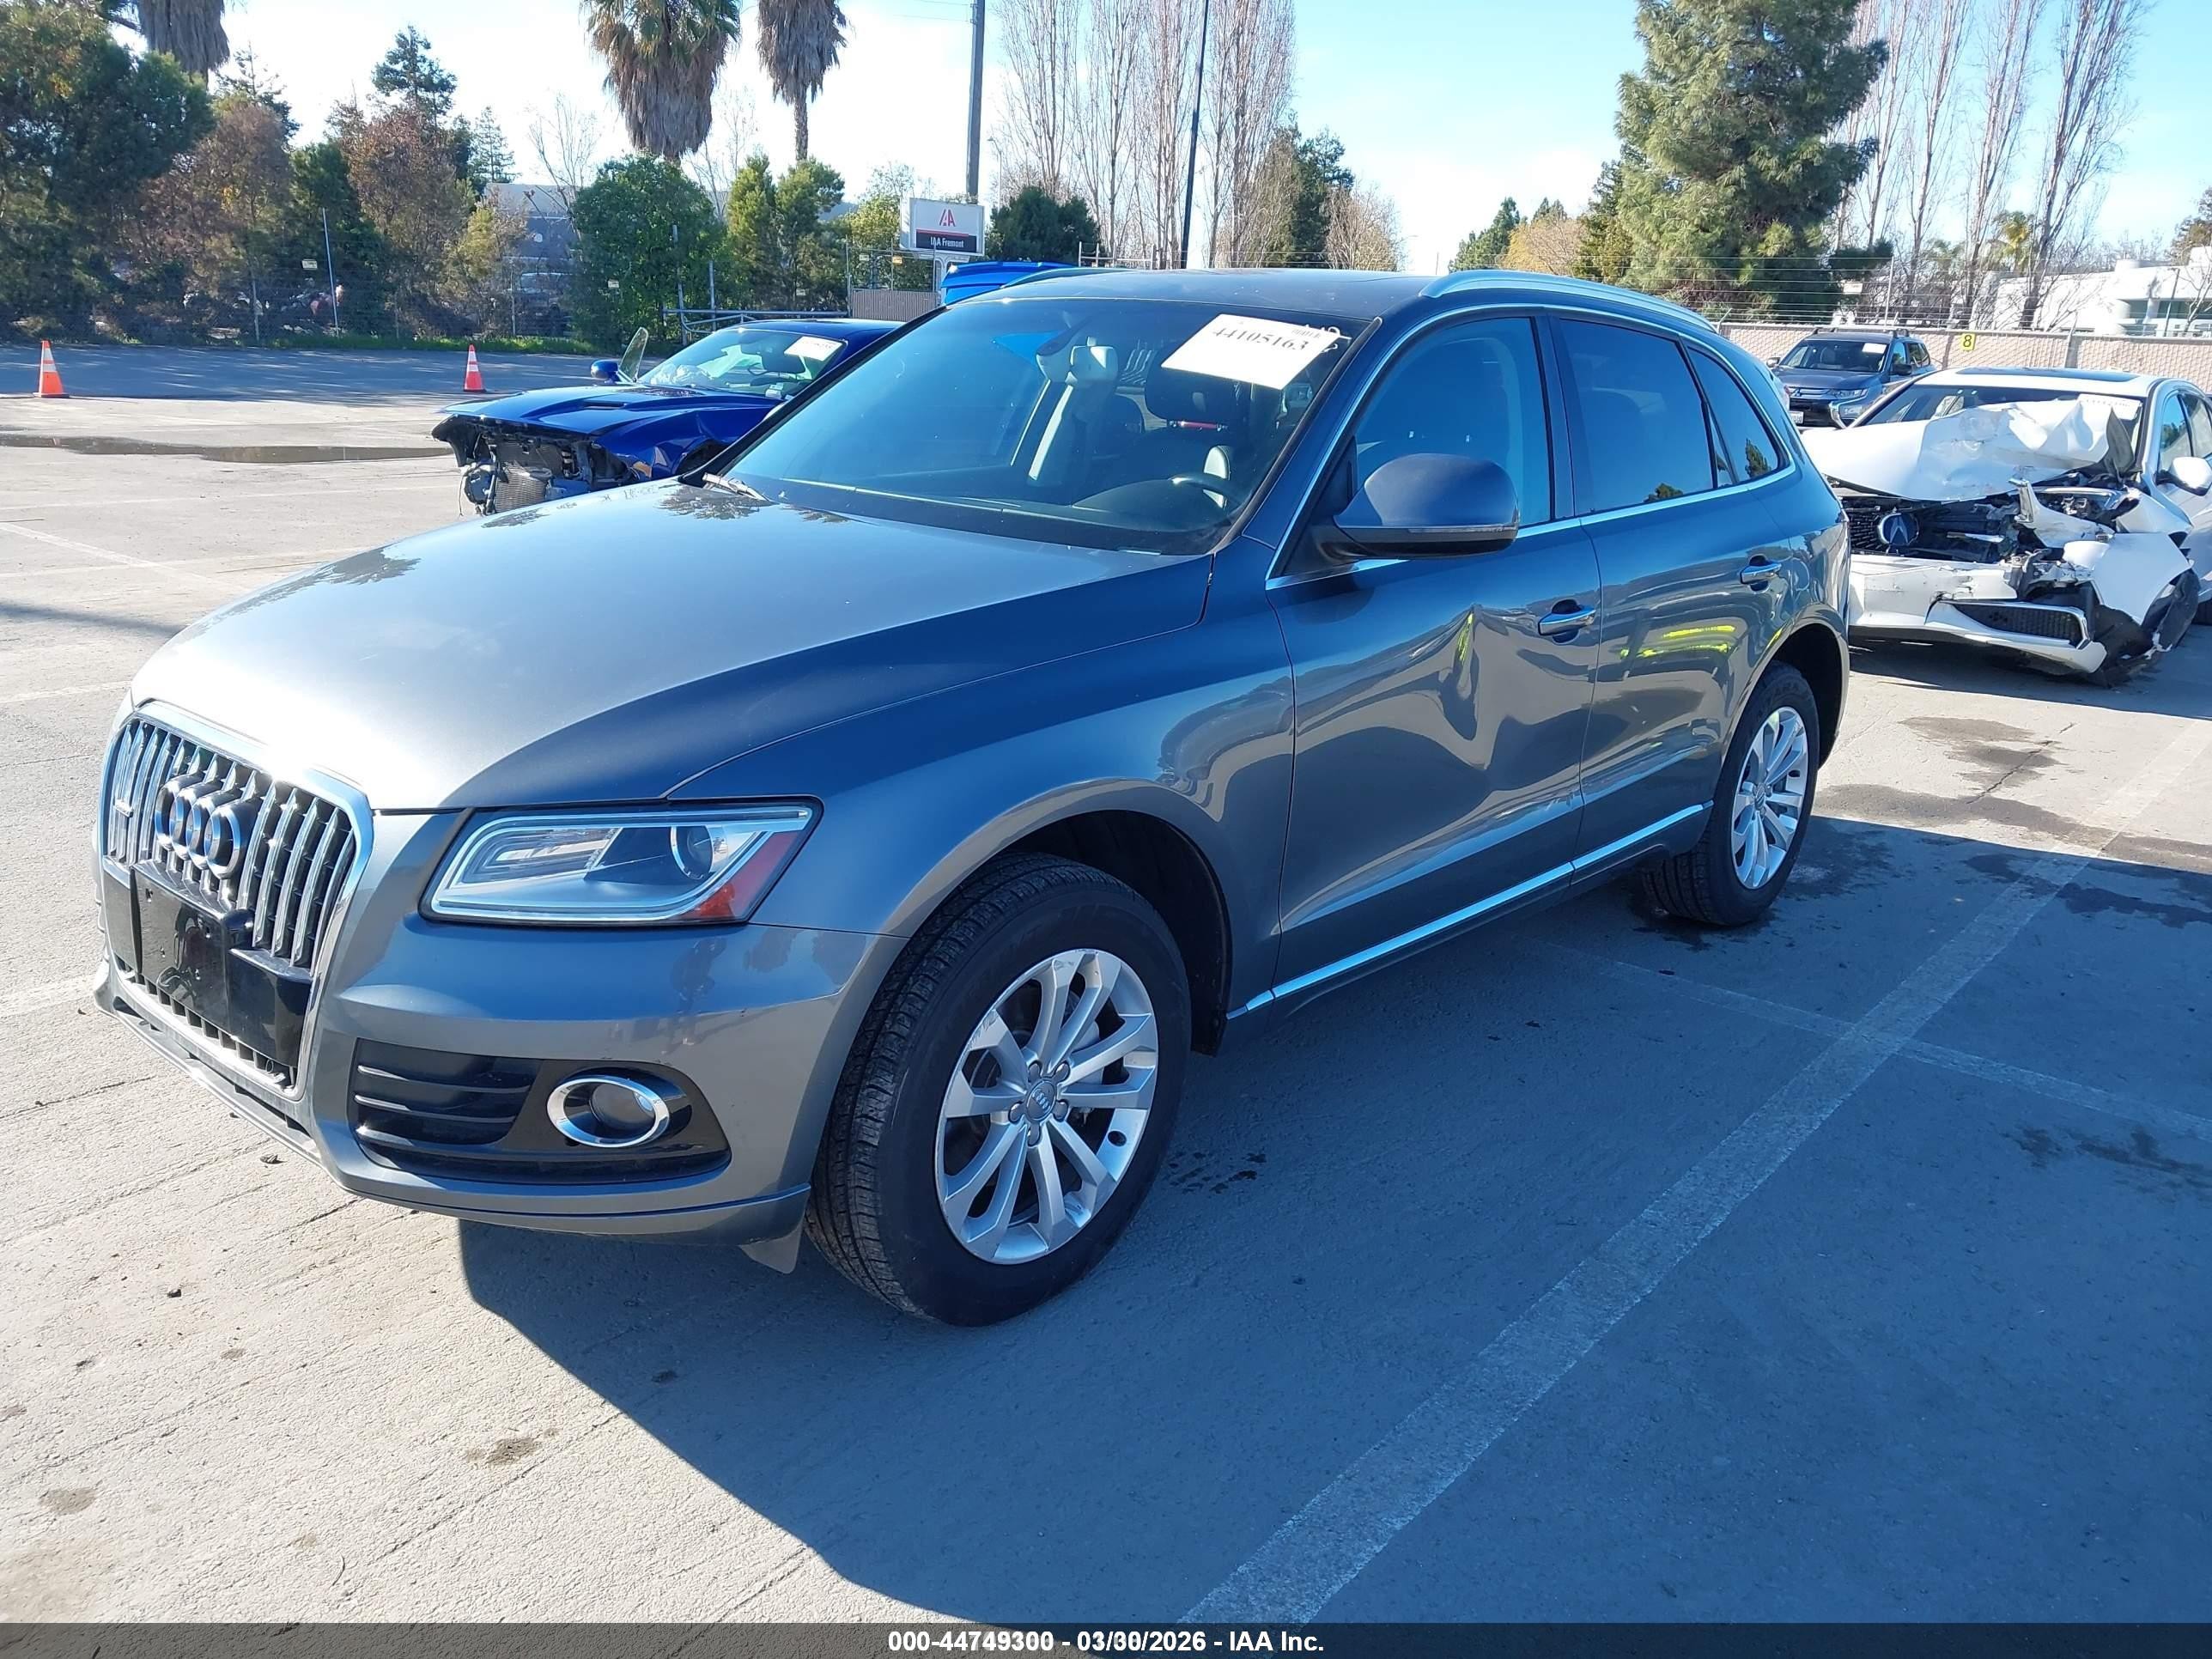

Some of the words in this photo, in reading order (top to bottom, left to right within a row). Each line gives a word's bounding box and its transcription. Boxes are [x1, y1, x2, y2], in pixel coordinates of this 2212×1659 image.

[942, 237, 964, 248] Fremont
[1212, 327, 1310, 351] 44105163
[1963, 334, 1972, 348] 8
